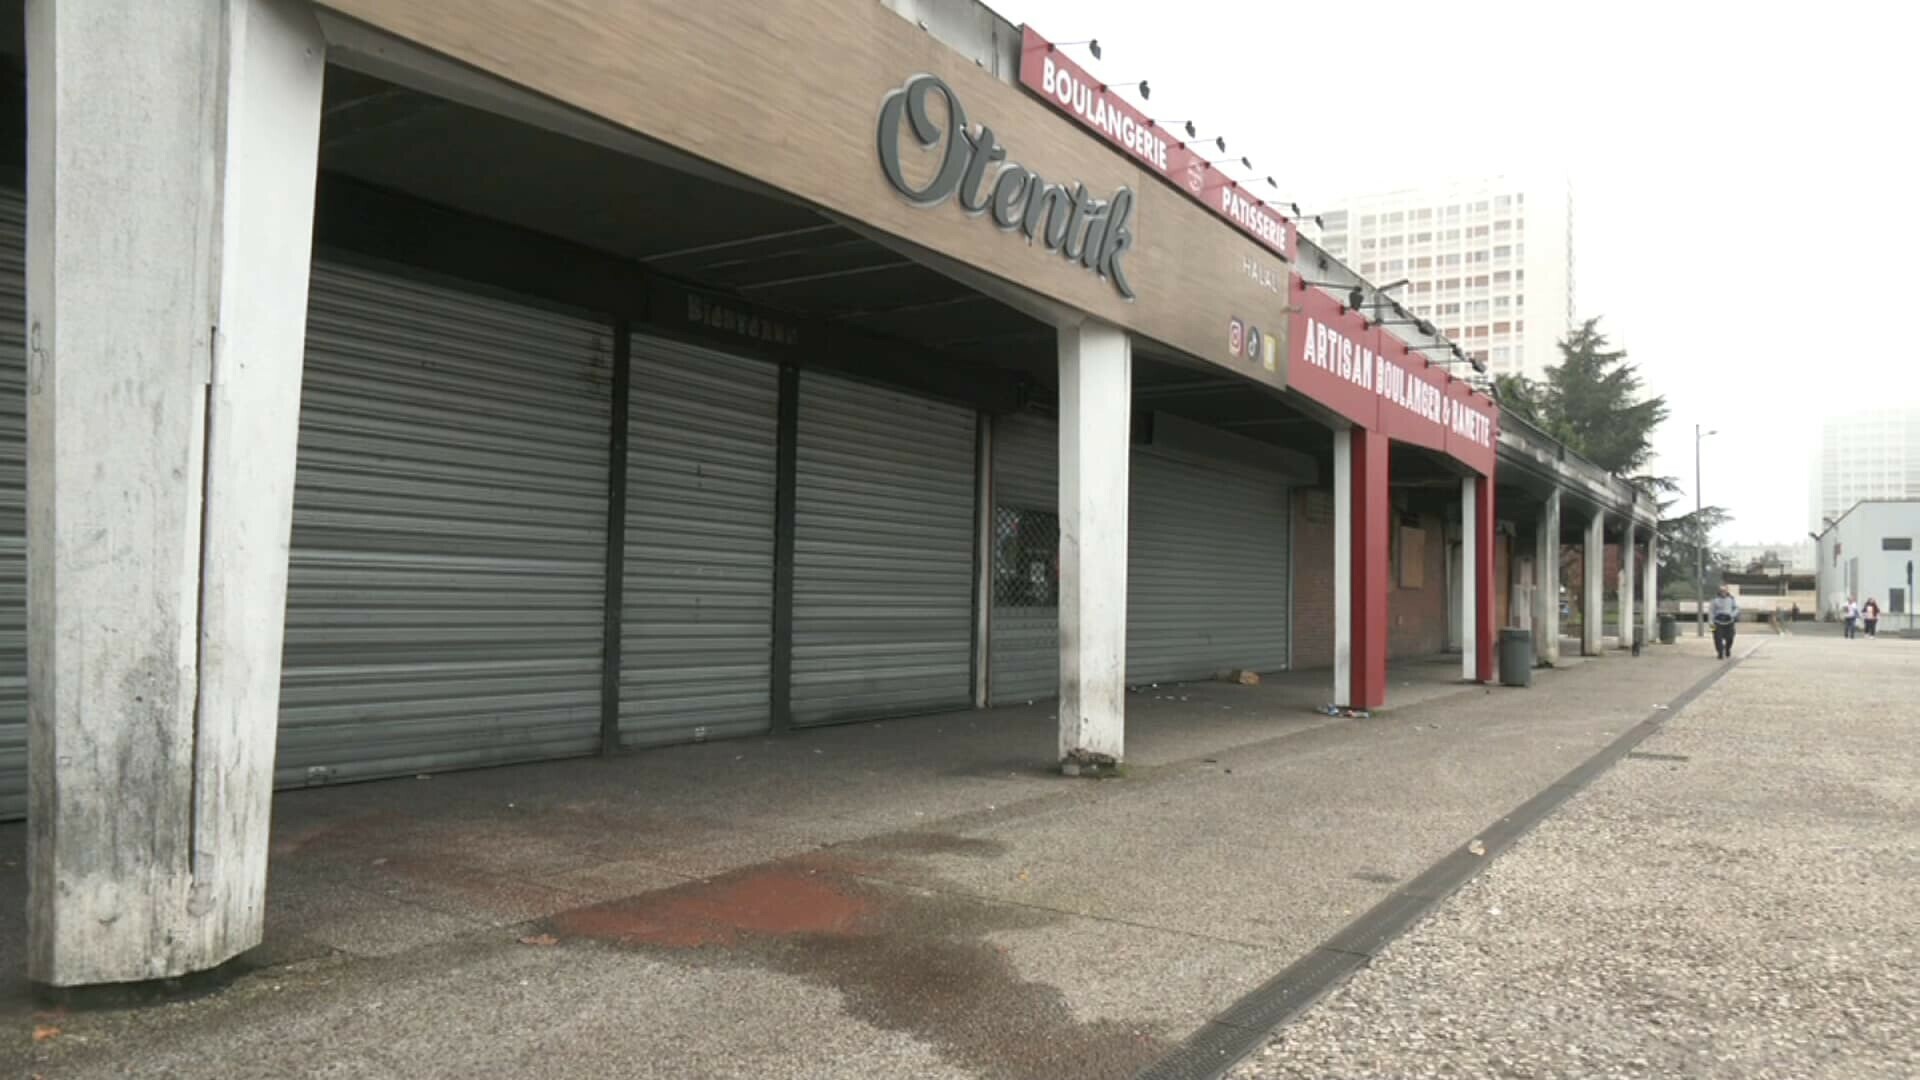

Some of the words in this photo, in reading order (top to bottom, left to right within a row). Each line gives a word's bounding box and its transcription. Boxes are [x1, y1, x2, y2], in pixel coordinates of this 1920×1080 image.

[877, 73, 1135, 302] Otentik
[1042, 56, 1167, 170] BOULANGERIE
[1221, 186, 1286, 250] PATISSERIE
[1242, 256, 1280, 293] HALAL
[1303, 317, 1373, 391] ARTISAN
[1375, 355, 1441, 424] BOULANGER
[1442, 396, 1451, 427] &
[1452, 399, 1490, 448] BANETTE
